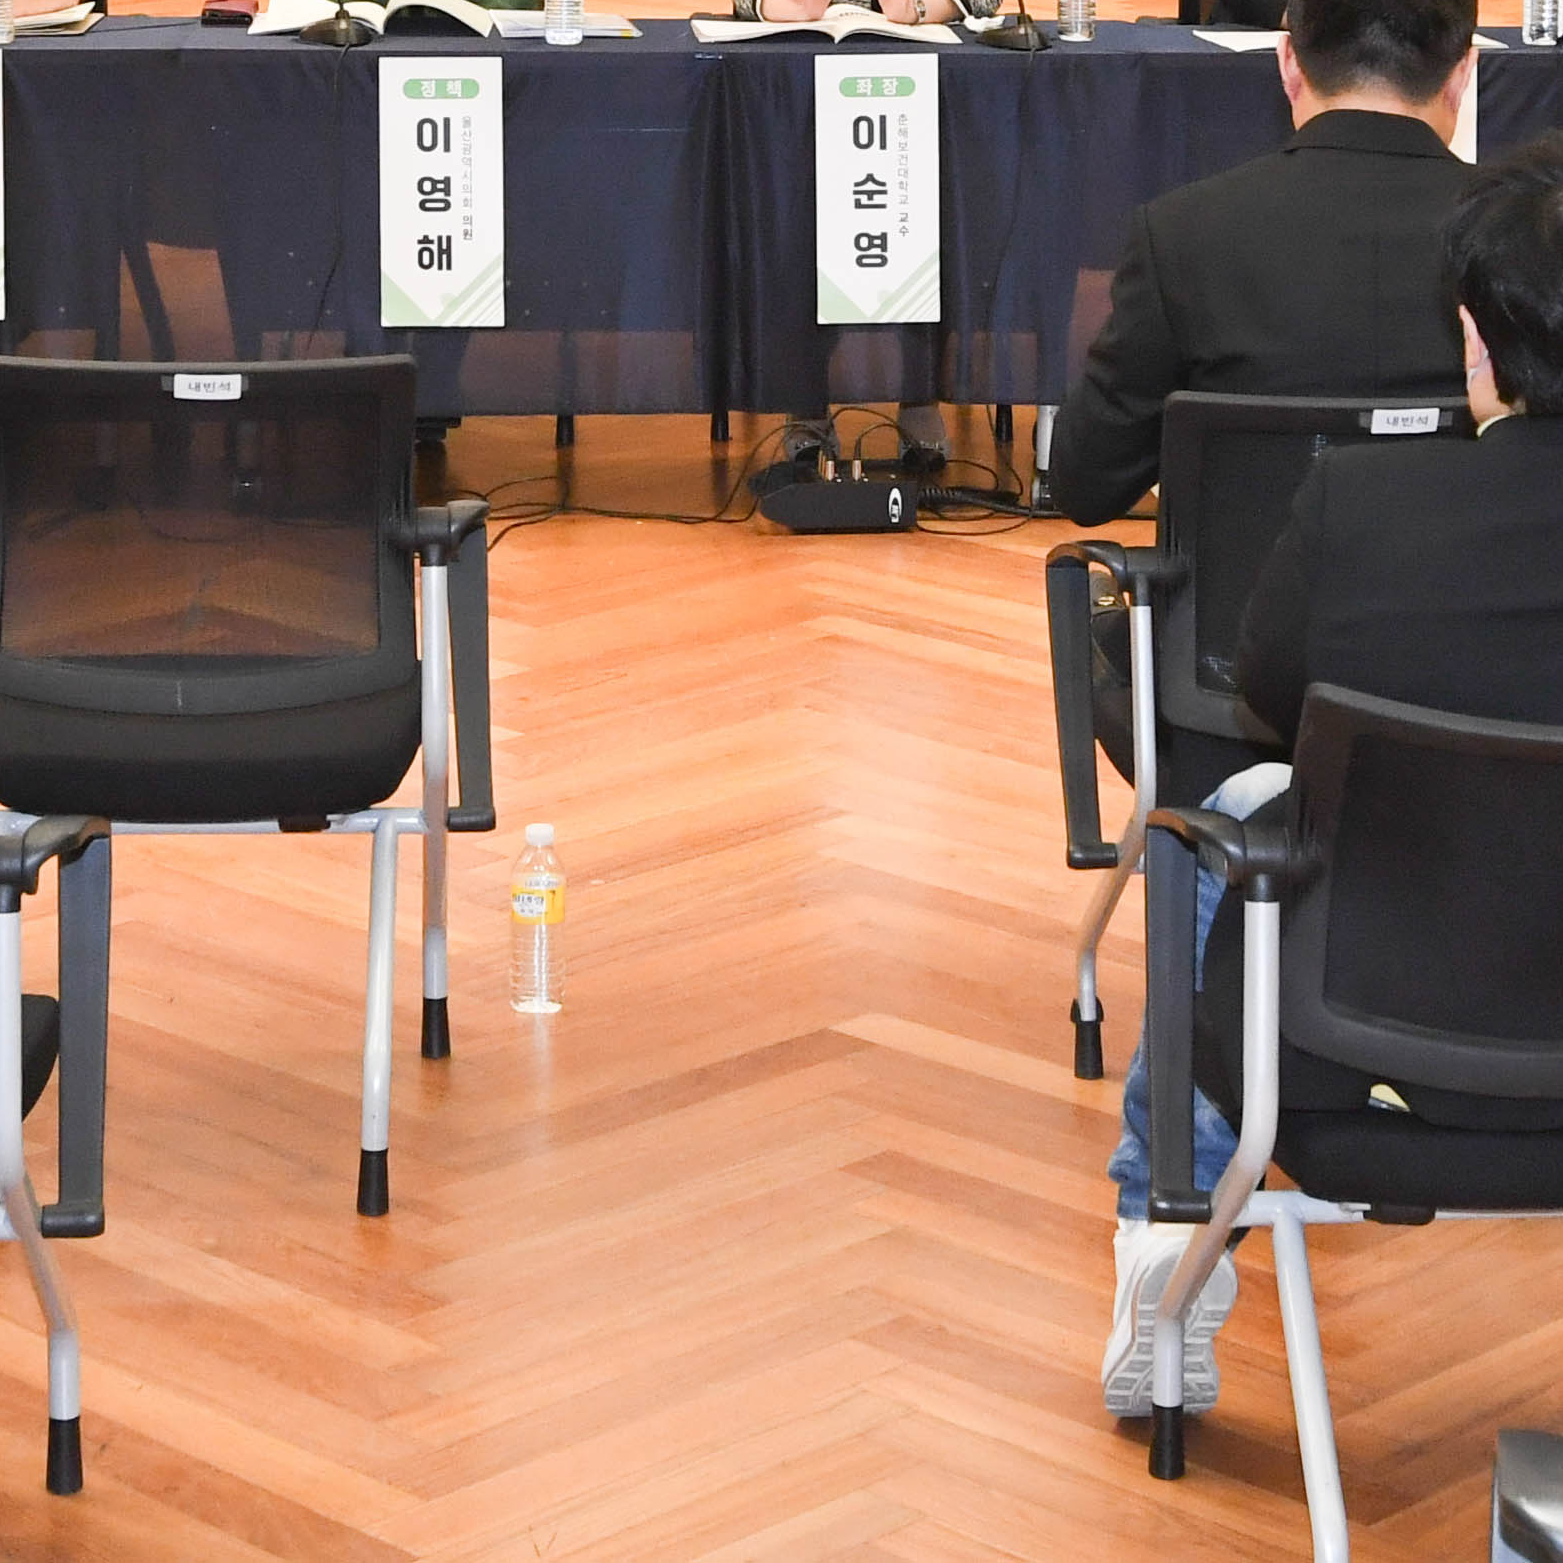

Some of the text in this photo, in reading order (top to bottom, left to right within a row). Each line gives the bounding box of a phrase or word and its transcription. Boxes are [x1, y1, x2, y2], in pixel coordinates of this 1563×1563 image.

[416, 117, 452, 271] 이영해
[852, 114, 889, 268] 이순영
[899, 212, 909, 237] 교수
[188, 380, 231, 393] 내빈석
[1385, 415, 1429, 427] 내빈석
